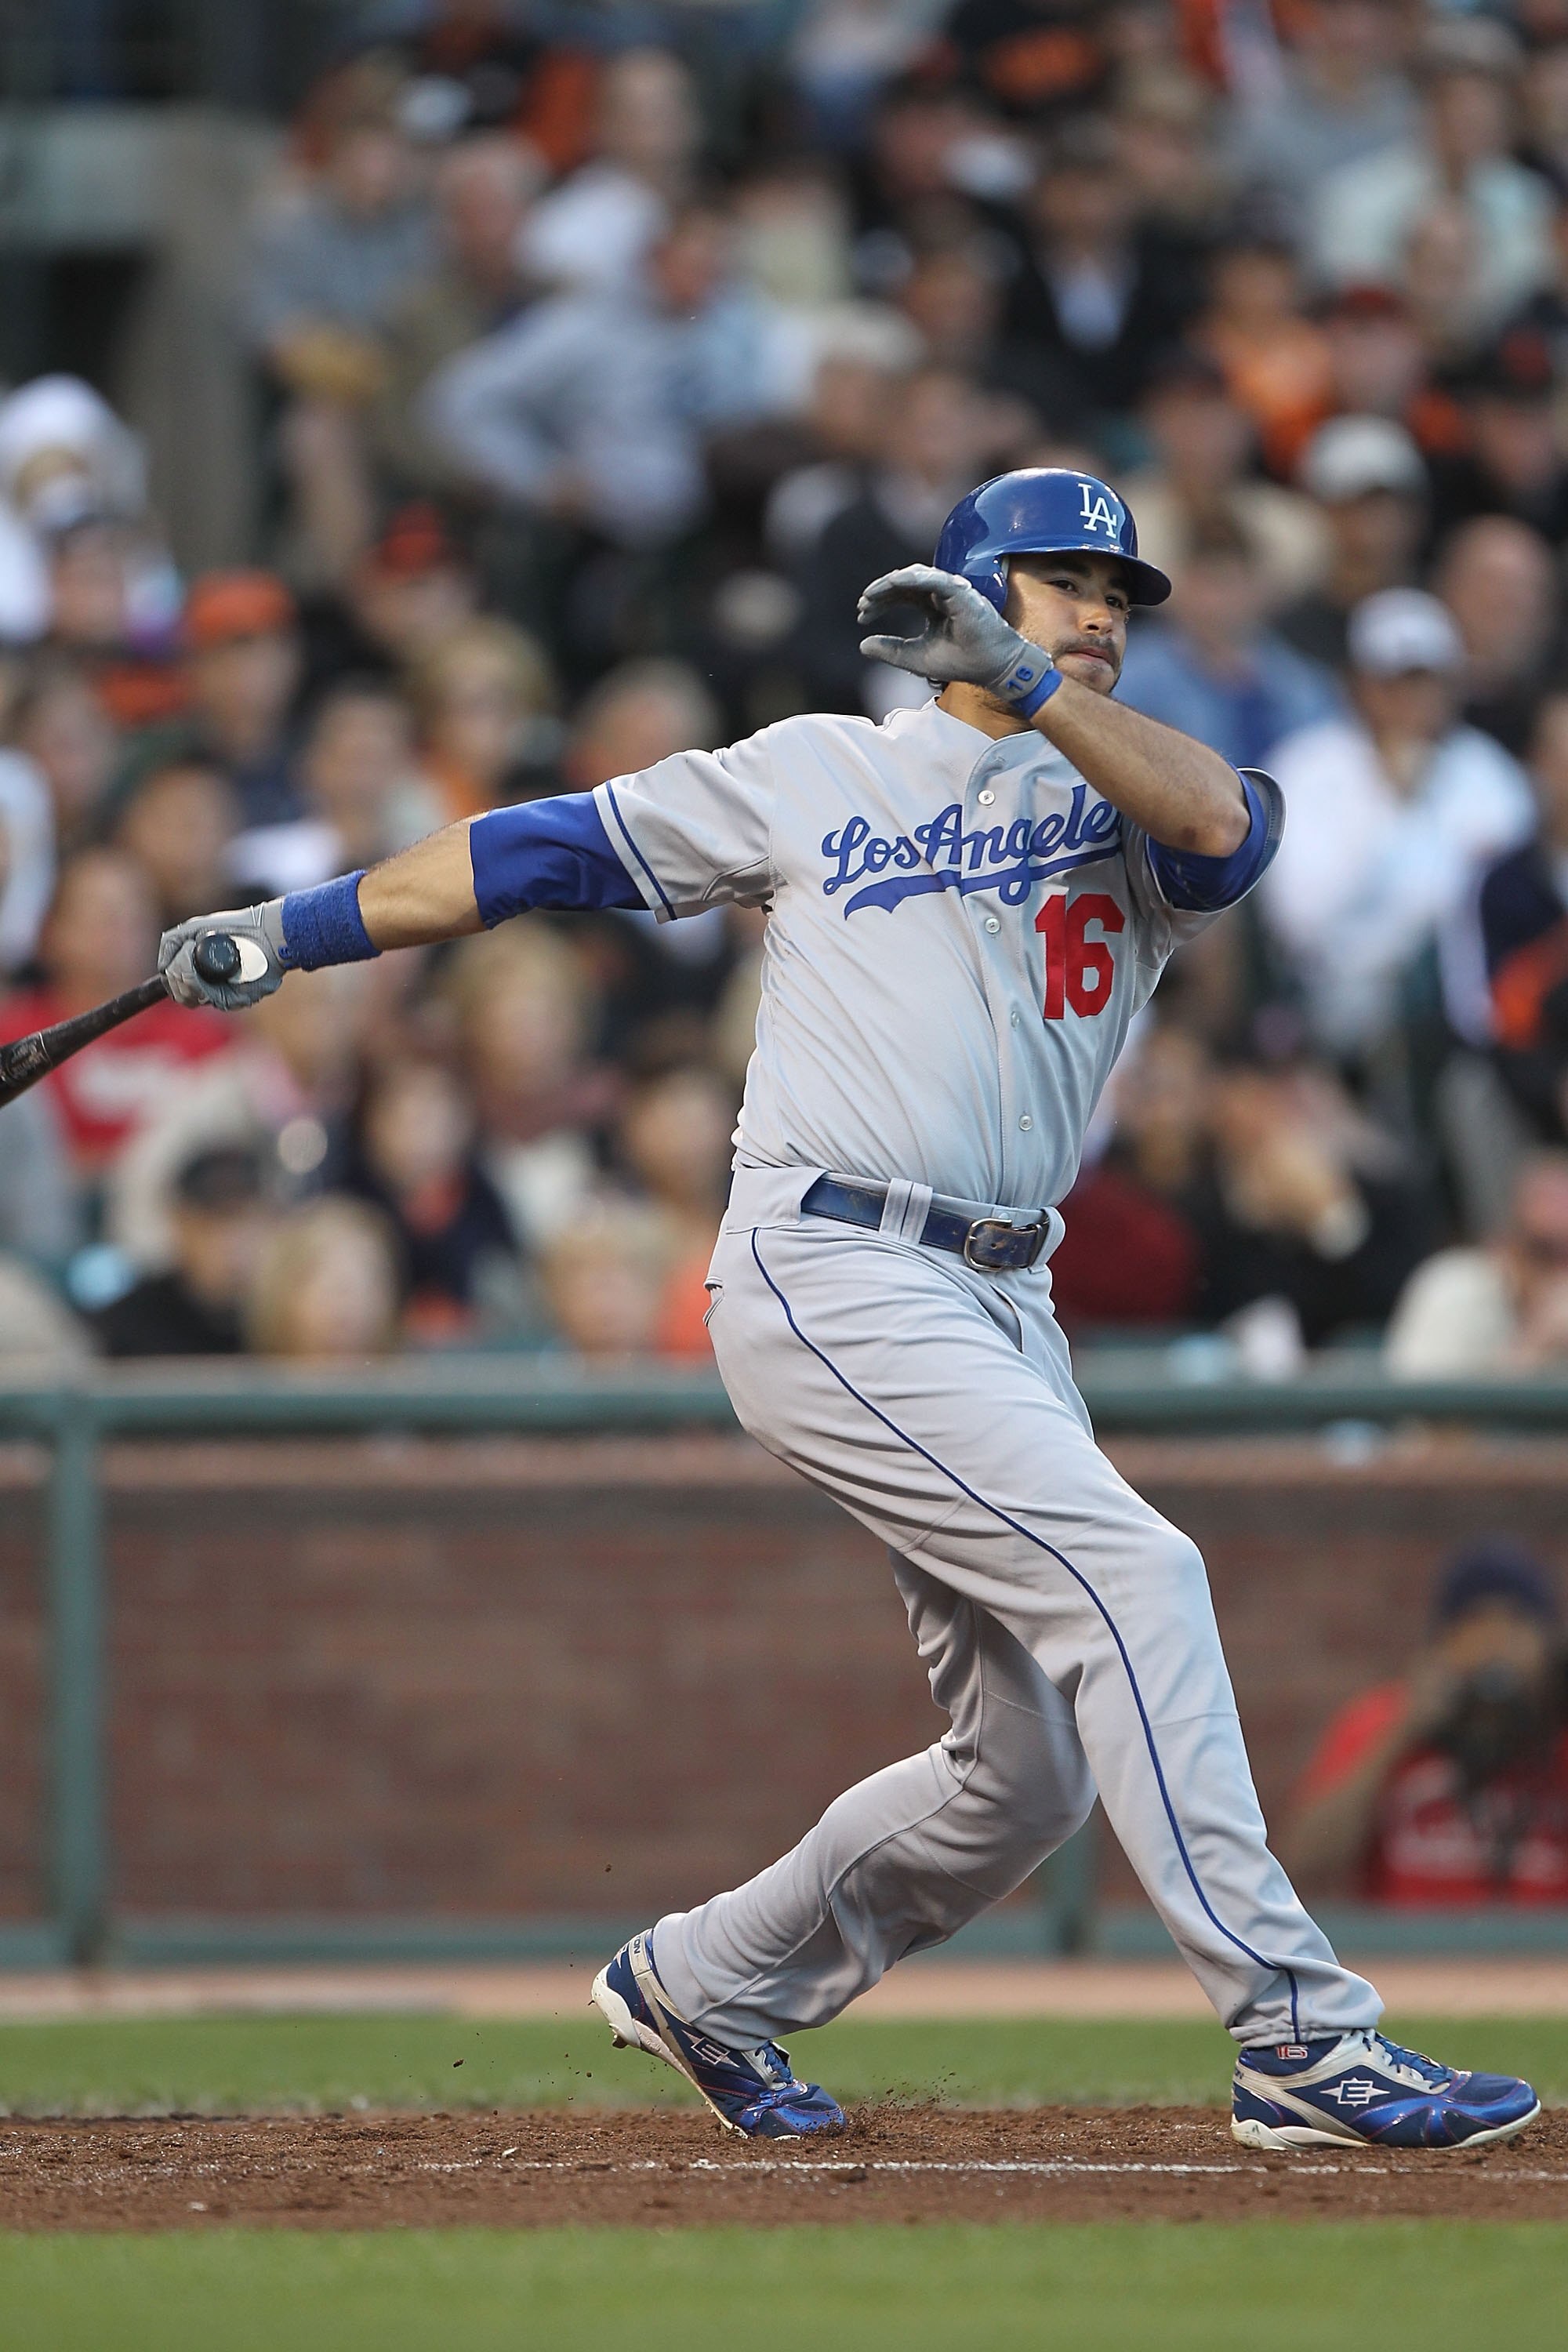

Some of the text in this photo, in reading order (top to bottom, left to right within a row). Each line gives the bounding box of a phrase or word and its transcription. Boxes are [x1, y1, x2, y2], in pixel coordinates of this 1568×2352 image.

[1077, 482, 1117, 539] LA
[1006, 666, 1033, 690] 16
[822, 783, 1119, 906] Los Angele
[1034, 893, 1126, 1020] 16
[1276, 2045, 1308, 2060] 16
[1338, 2080, 1374, 2104] E
